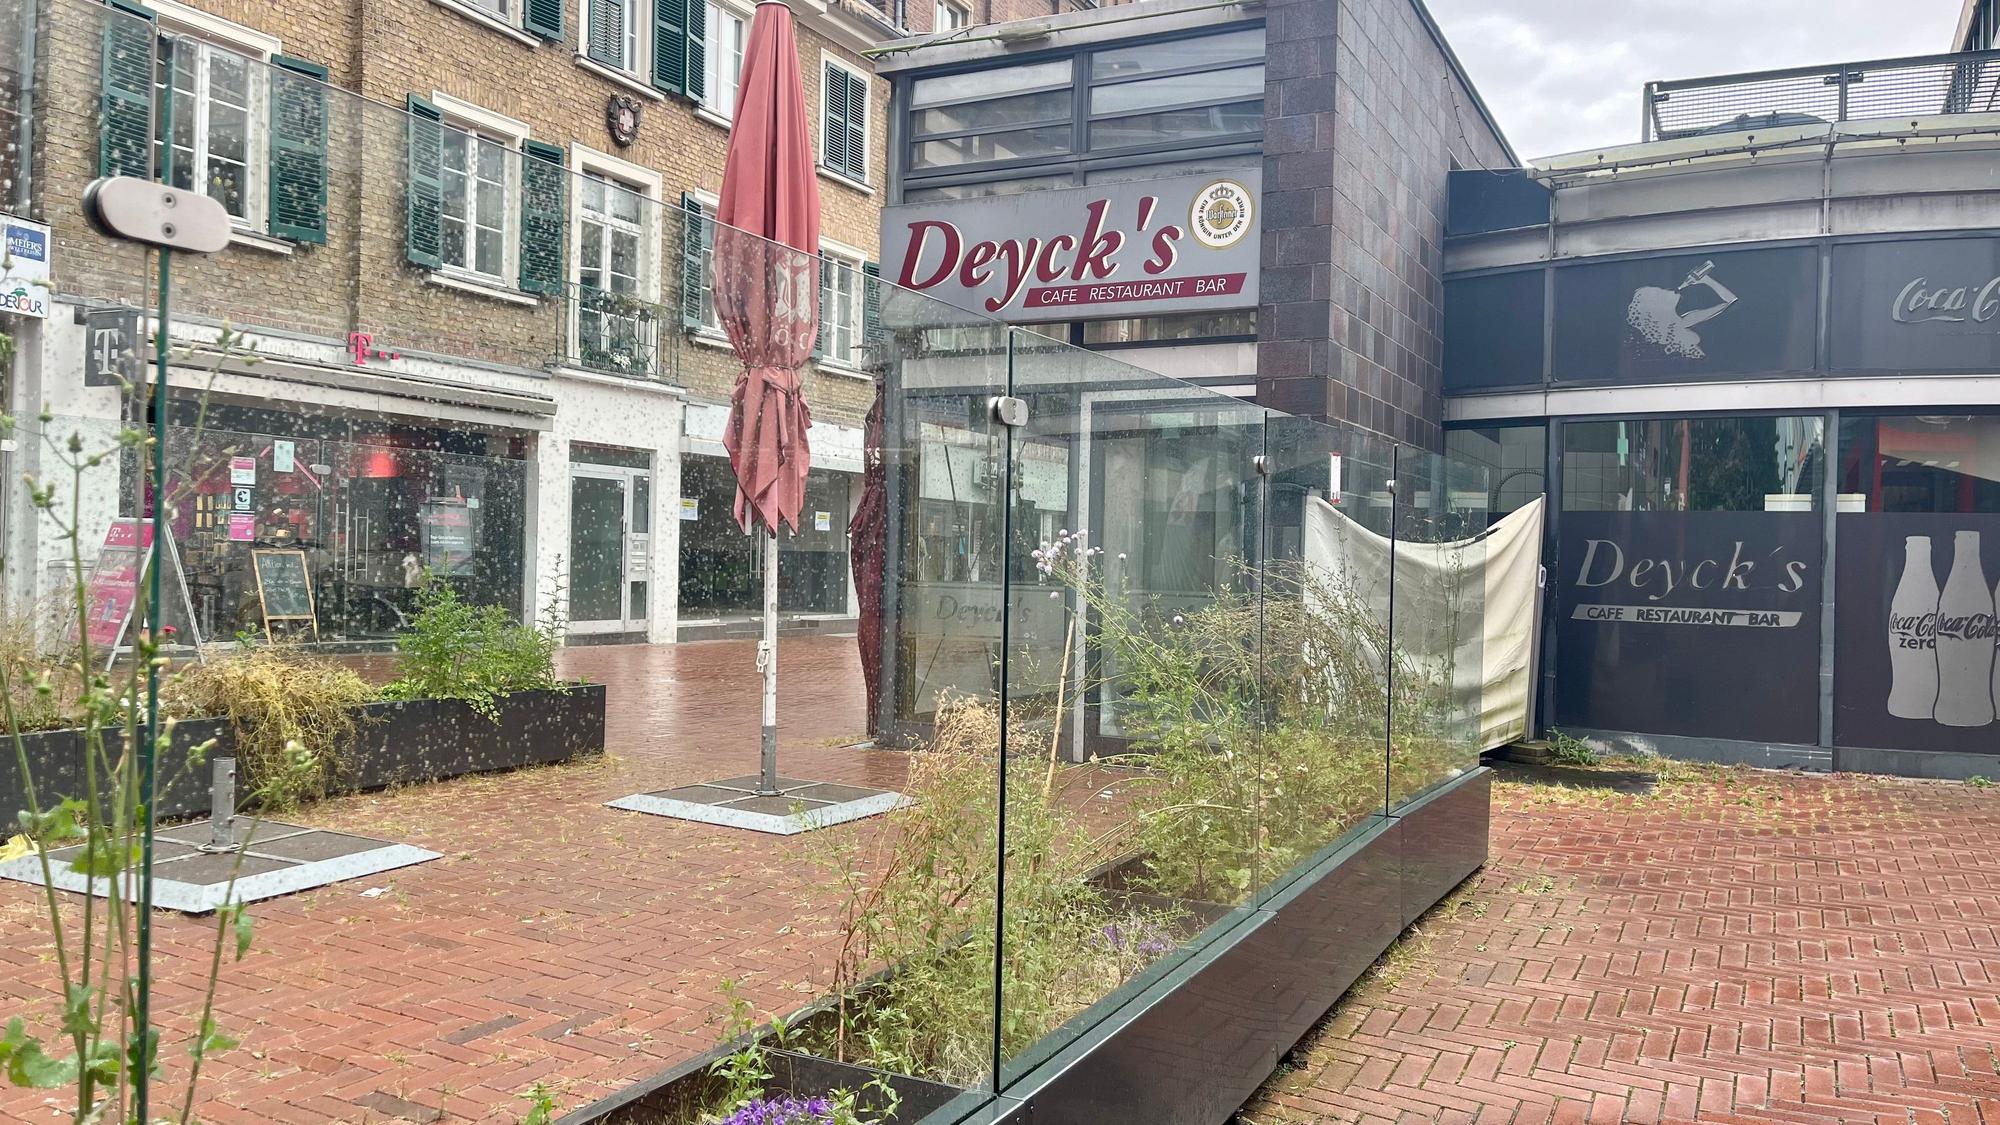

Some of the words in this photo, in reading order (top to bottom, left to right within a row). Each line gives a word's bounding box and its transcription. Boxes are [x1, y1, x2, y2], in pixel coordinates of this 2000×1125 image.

[1199, 199, 1208, 213] EINE
[1235, 196, 1245, 218] BIEREN
[1213, 231, 1233, 239] UNTER
[1232, 219, 1243, 232] DEN
[898, 196, 1185, 312] Deyck's
[1041, 288, 1077, 304] CAFE
[1089, 281, 1184, 300] RESTAURANT
[1195, 278, 1226, 293] BAR
[1586, 607, 1623, 621] CAFE
[1636, 608, 1735, 625] RESTAURANT
[1748, 612, 1780, 627] BAR
